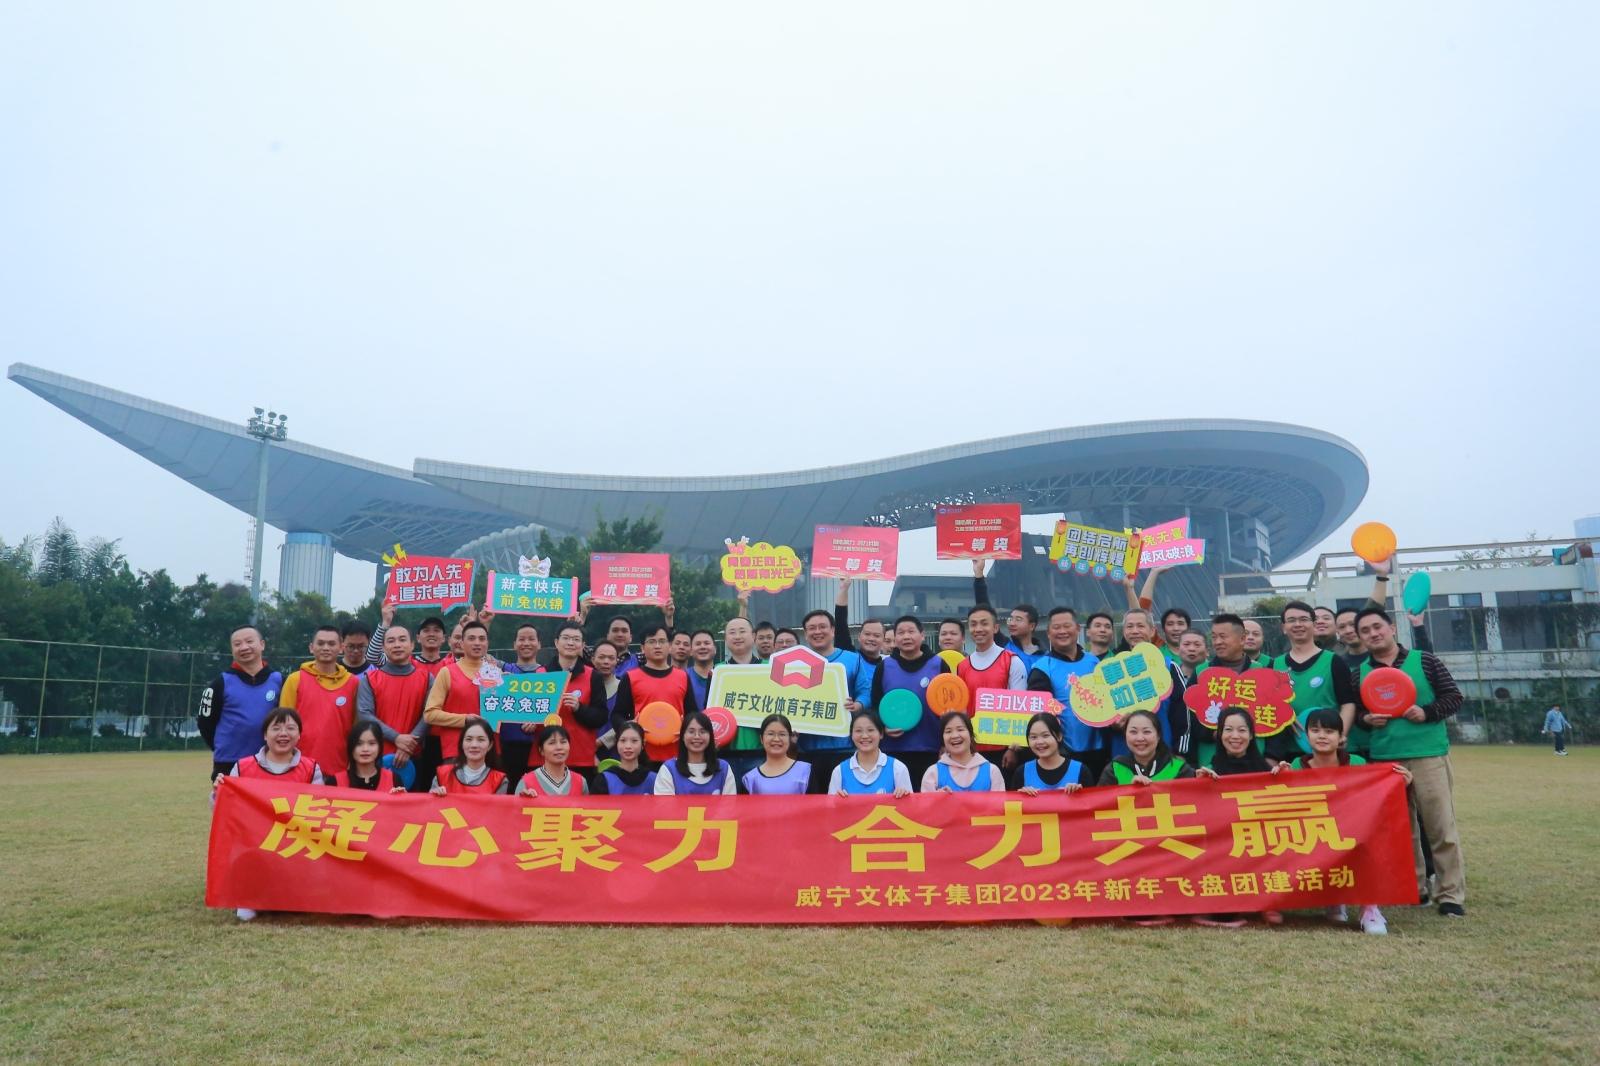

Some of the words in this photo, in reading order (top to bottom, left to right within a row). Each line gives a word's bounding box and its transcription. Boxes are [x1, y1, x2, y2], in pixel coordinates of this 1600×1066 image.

[950, 537, 1009, 551] 一等奖
[1067, 527, 1129, 551] 团结启航
[826, 557, 883, 571] 二等奖
[1064, 542, 1126, 567] 再创辉煌
[1140, 544, 1196, 565] 乘风破浪
[396, 564, 462, 583] 敢为人先
[400, 582, 465, 602] 追求卓越
[501, 577, 564, 595] 新年快乐
[603, 584, 659, 597] 优胜奖
[500, 594, 564, 611] 前兔似锦
[508, 680, 556, 693] 2023
[1207, 677, 1257, 702] 好运
[484, 695, 550, 713] 奋发兔强
[723, 691, 838, 720] 威宁文化体育子集团
[979, 693, 1045, 712] 全力以赴
[1229, 702, 1278, 728] 连
[259, 793, 739, 873] 凝心聚力
[832, 783, 1357, 874] 合力共赢
[795, 865, 1355, 907] 威宁文体子集团2023年新年飞盘团建活动
